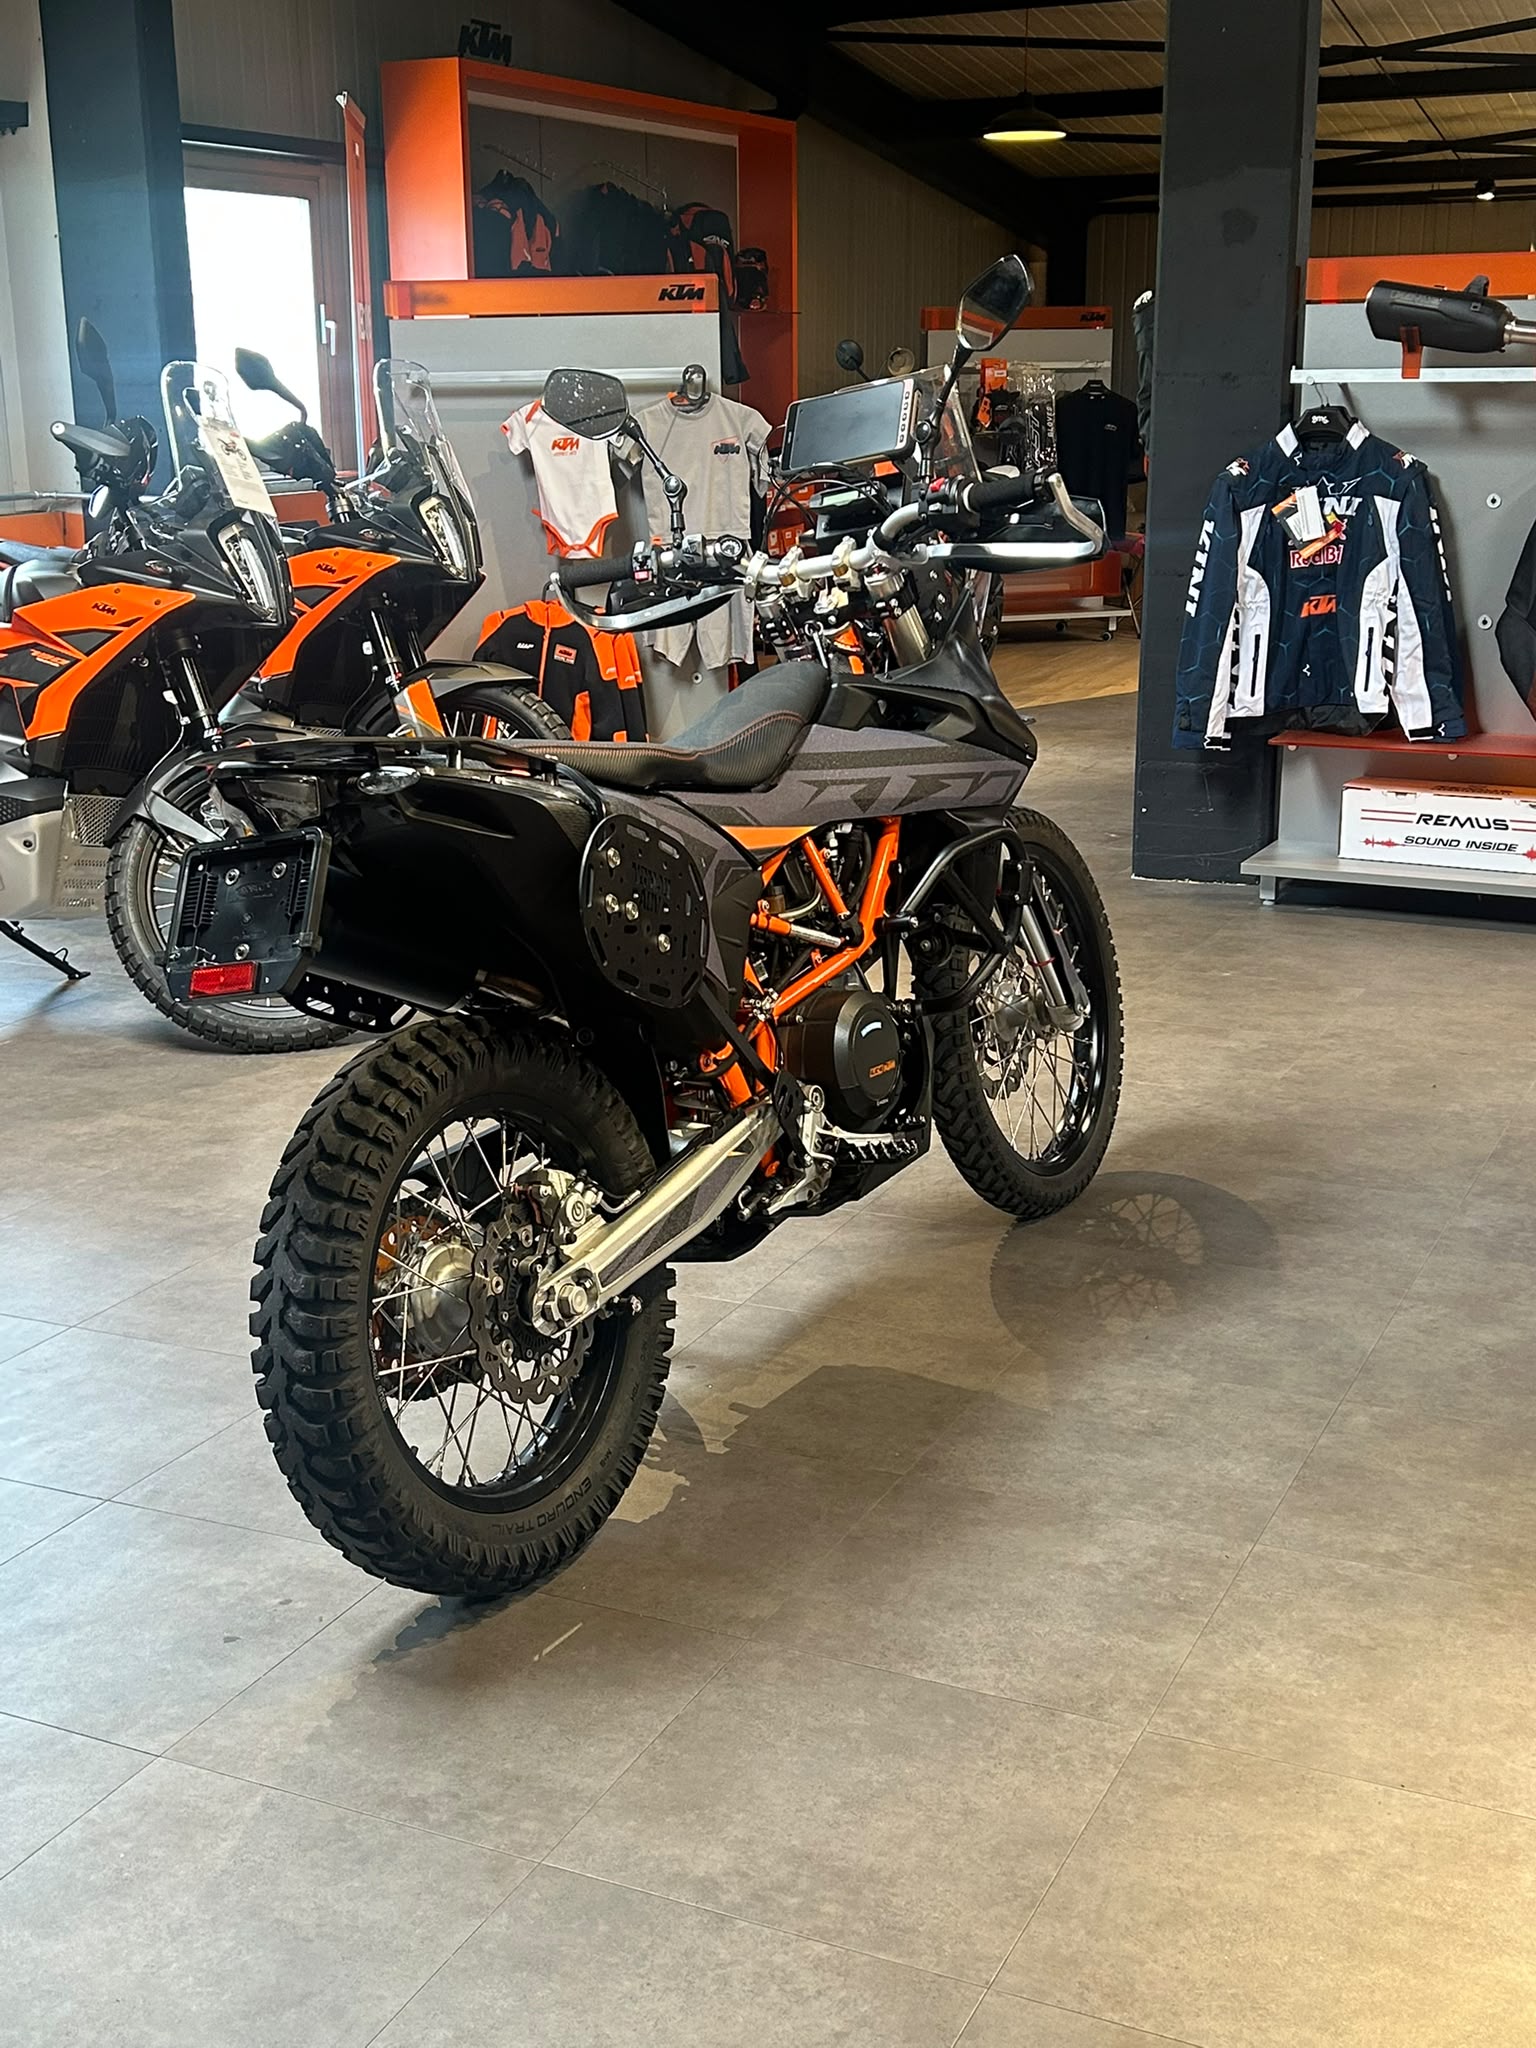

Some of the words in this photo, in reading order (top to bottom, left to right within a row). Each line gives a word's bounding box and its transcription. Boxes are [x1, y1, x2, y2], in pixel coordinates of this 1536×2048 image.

[458, 19, 512, 63] KTM
[658, 283, 705, 301] KTM
[551, 437, 580, 451] KTM
[91, 602, 118, 616] KTM
[1415, 813, 1510, 831] REMUS
[1403, 835, 1461, 848] SOUND
[1465, 840, 1520, 853] INSIDE
[536, 1476, 593, 1528] ENDURO
[491, 1518, 535, 1536] TRAIL
